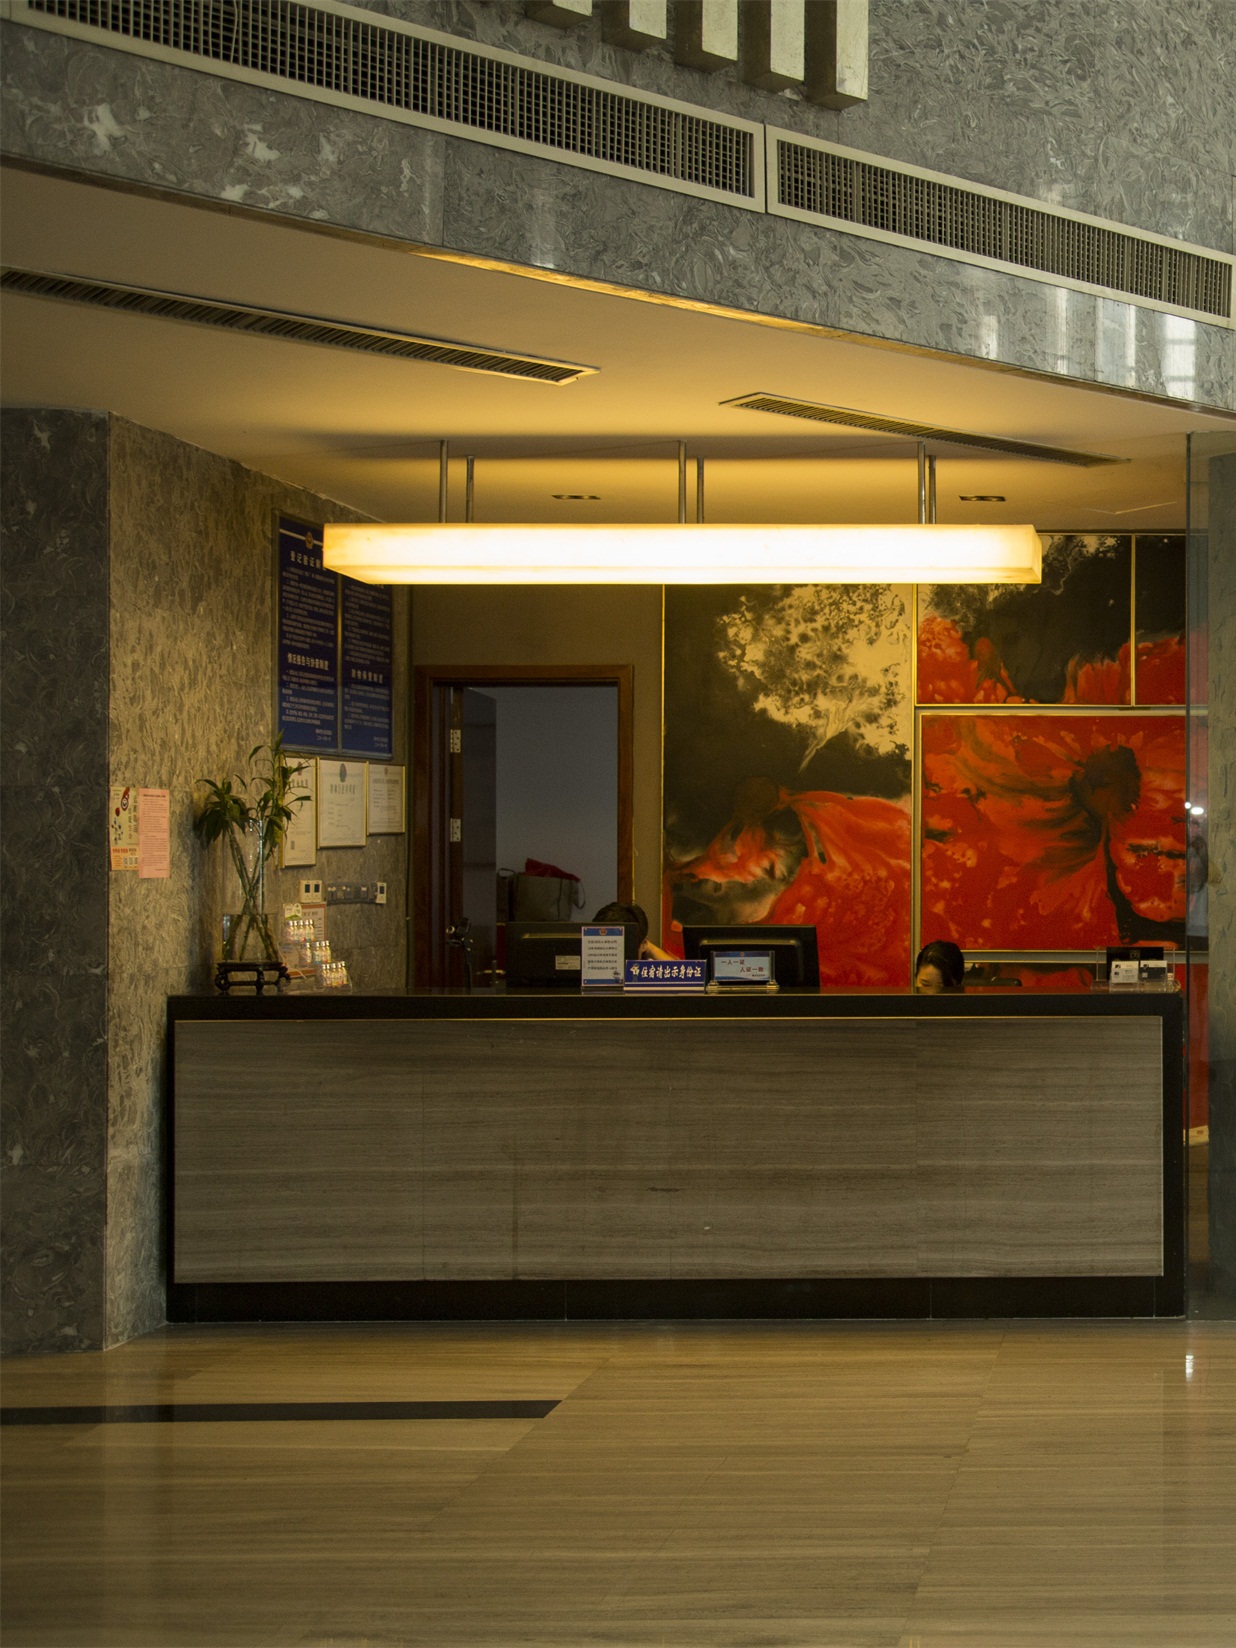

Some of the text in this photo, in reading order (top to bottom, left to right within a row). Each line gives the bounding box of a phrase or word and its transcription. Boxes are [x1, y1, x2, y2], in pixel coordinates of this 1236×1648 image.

[641, 964, 702, 979] 住宿请出示身份证
